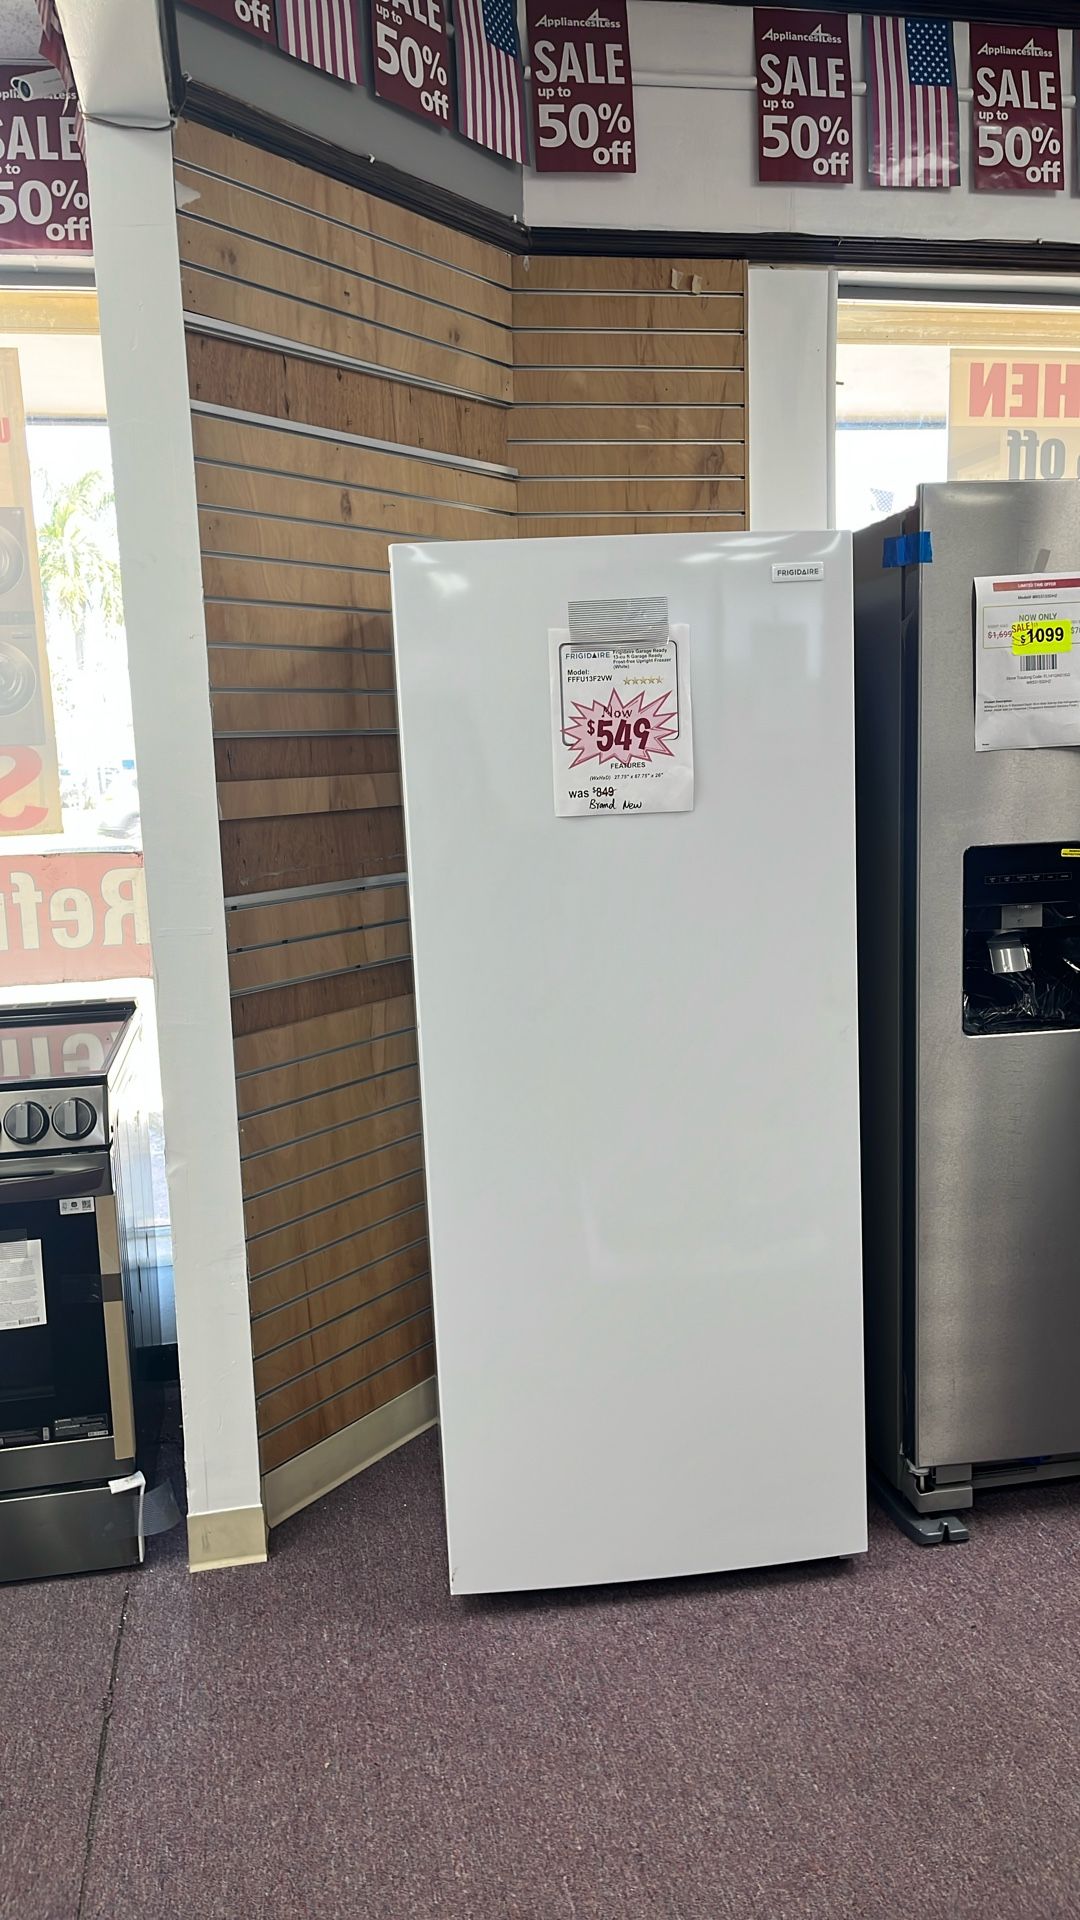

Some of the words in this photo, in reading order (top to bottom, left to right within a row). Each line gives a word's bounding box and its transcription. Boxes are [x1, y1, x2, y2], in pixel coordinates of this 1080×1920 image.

[235, 0, 271, 33] off
[376, 4, 389, 20] up
[391, 10, 402, 25] to
[377, 21, 448, 88] 50%
[534, 40, 626, 84] SALE
[760, 53, 846, 98] SALE
[538, 87, 555, 100] up
[557, 86, 571, 98] to
[976, 66, 1057, 110] SALE
[421, 90, 449, 120] off
[763, 100, 779, 111] up
[781, 99, 795, 110] to
[979, 111, 994, 122] up
[996, 110, 1009, 121] to
[0, 116, 81, 160] ALE
[538, 103, 631, 149] 50%
[763, 115, 850, 159] 50%
[593, 140, 631, 165] off
[978, 126, 1061, 168] 50%
[5, 163, 20, 174] to
[812, 152, 850, 176] off
[1026, 161, 1061, 183] off
[0, 180, 88, 225] 50%
[46, 217, 90, 241] off
[777, 567, 820, 576] FRIGIDAIRE
[1018, 614, 1036, 622] NOW
[1038, 612, 1058, 620] ONLY
[1020, 627, 1064, 643] $1099
[565, 652, 611, 660] FRIGIDAIRE
[567, 674, 613, 683] FFFU13F2VW
[601, 706, 633, 718] Now
[586, 717, 651, 752] $549
[568, 789, 590, 798] was
[592, 786, 615, 798] $849
[588, 798, 616, 810] Brand
[622, 800, 643, 810] New
